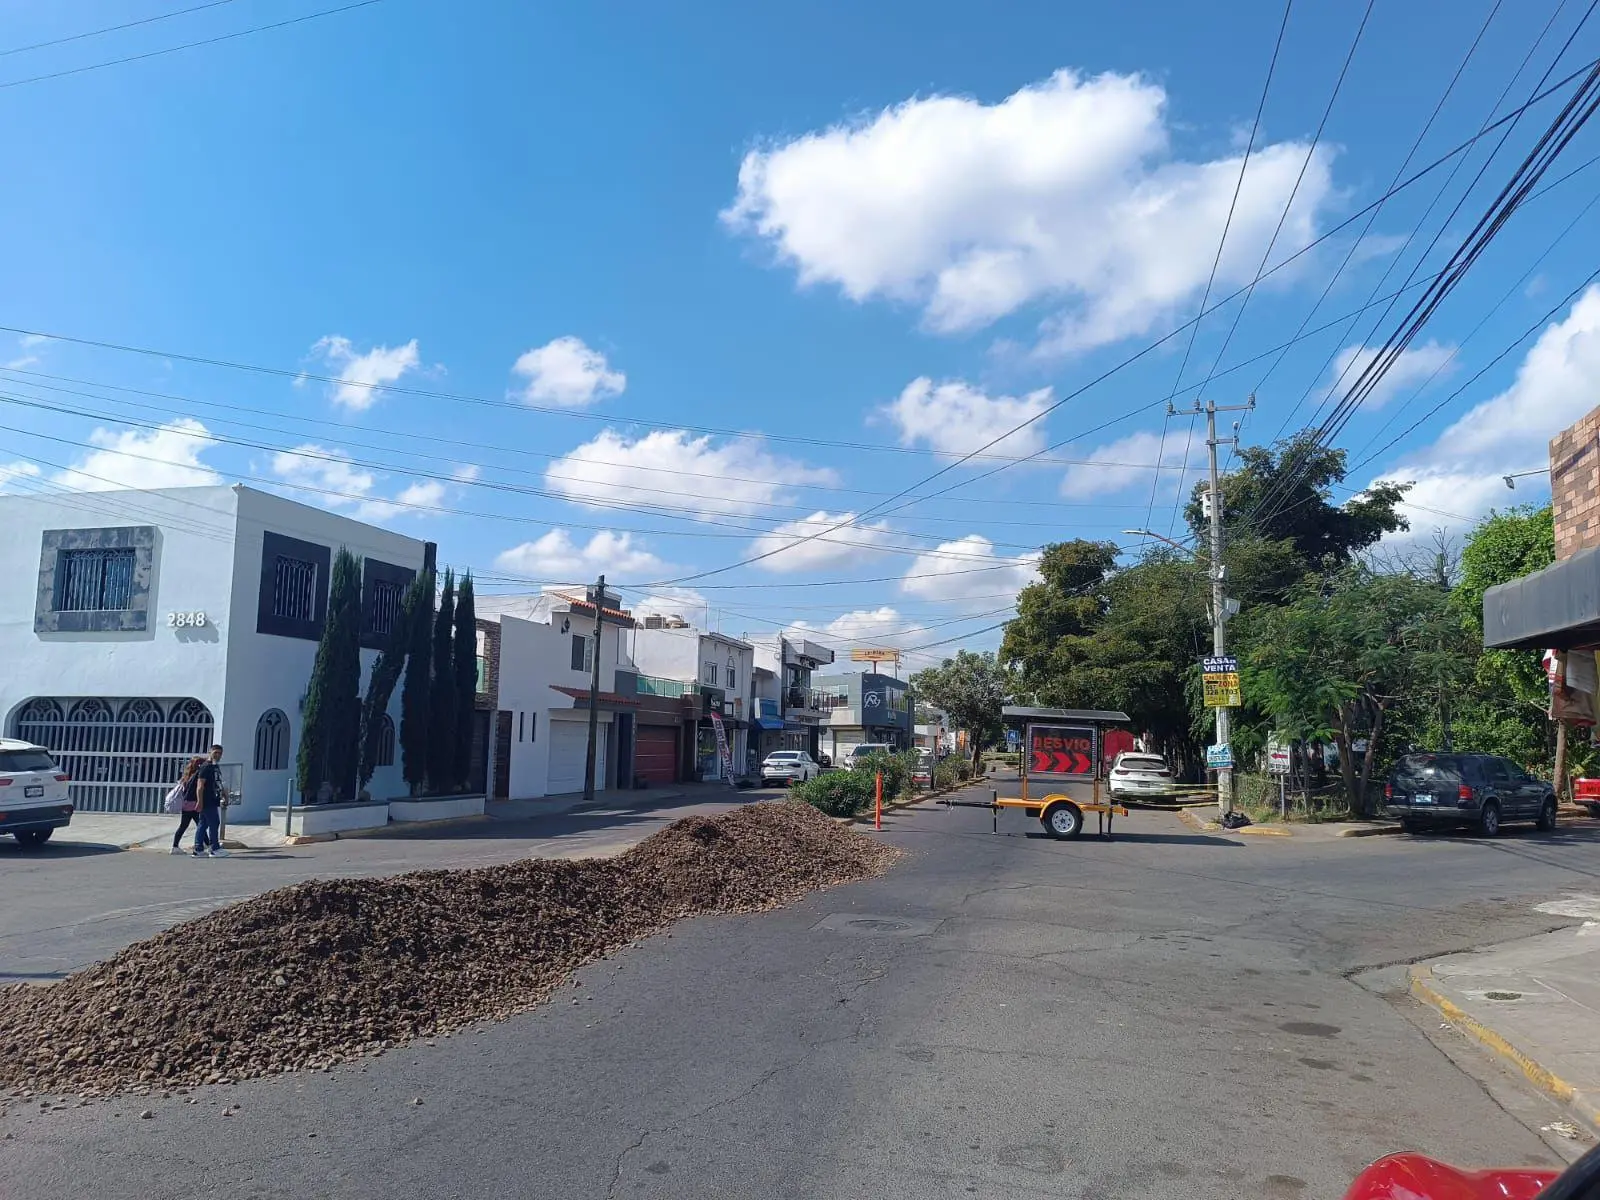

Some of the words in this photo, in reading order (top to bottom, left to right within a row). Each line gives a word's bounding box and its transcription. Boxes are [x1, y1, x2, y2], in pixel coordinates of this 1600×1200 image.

[167, 611, 205, 627] 2848
[1203, 657, 1229, 665] CASA
[1203, 664, 1236, 672] VENTA
[1219, 680, 1239, 688] ZONA
[1033, 735, 1091, 751] DESVIO
